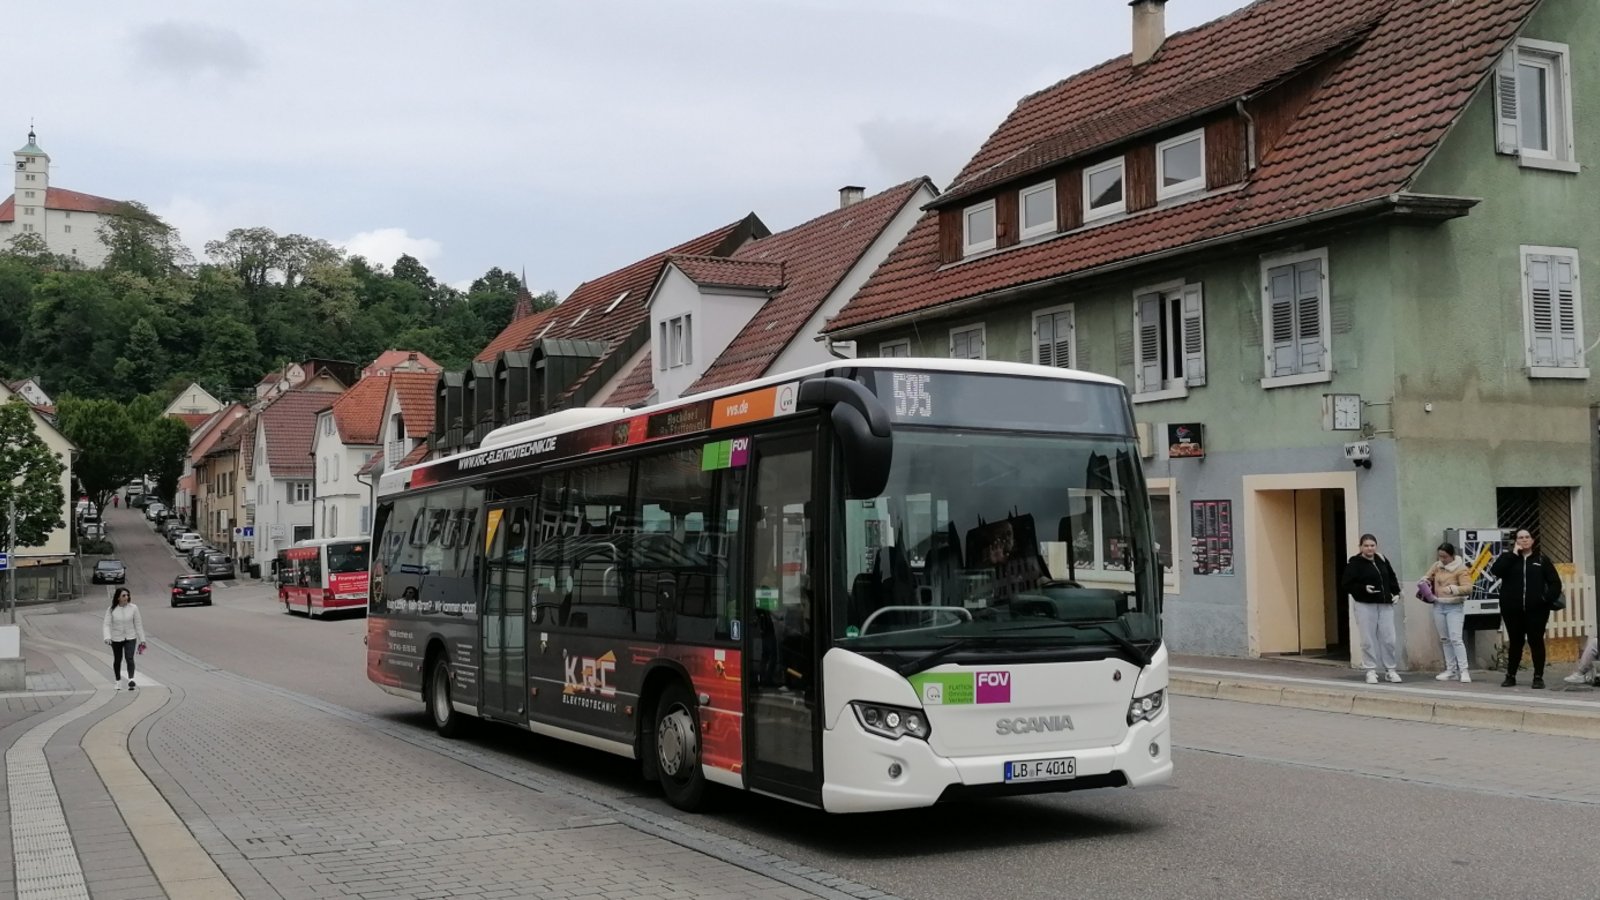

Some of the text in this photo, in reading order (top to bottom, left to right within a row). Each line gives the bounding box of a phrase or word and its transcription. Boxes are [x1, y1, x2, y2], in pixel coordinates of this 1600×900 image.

[893, 372, 931, 416] 595
[726, 401, 748, 416] vvs.de
[458, 436, 557, 470] WWW.KRC-ELEKTROTECHNIK.DE
[732, 438, 748, 452] FOV
[563, 654, 617, 697] KRC
[978, 673, 1009, 686] FOV
[562, 694, 617, 713] ELEKTROTECHNIK
[996, 715, 1074, 735] SCANIA
[1013, 760, 1074, 777] LB F 4016
